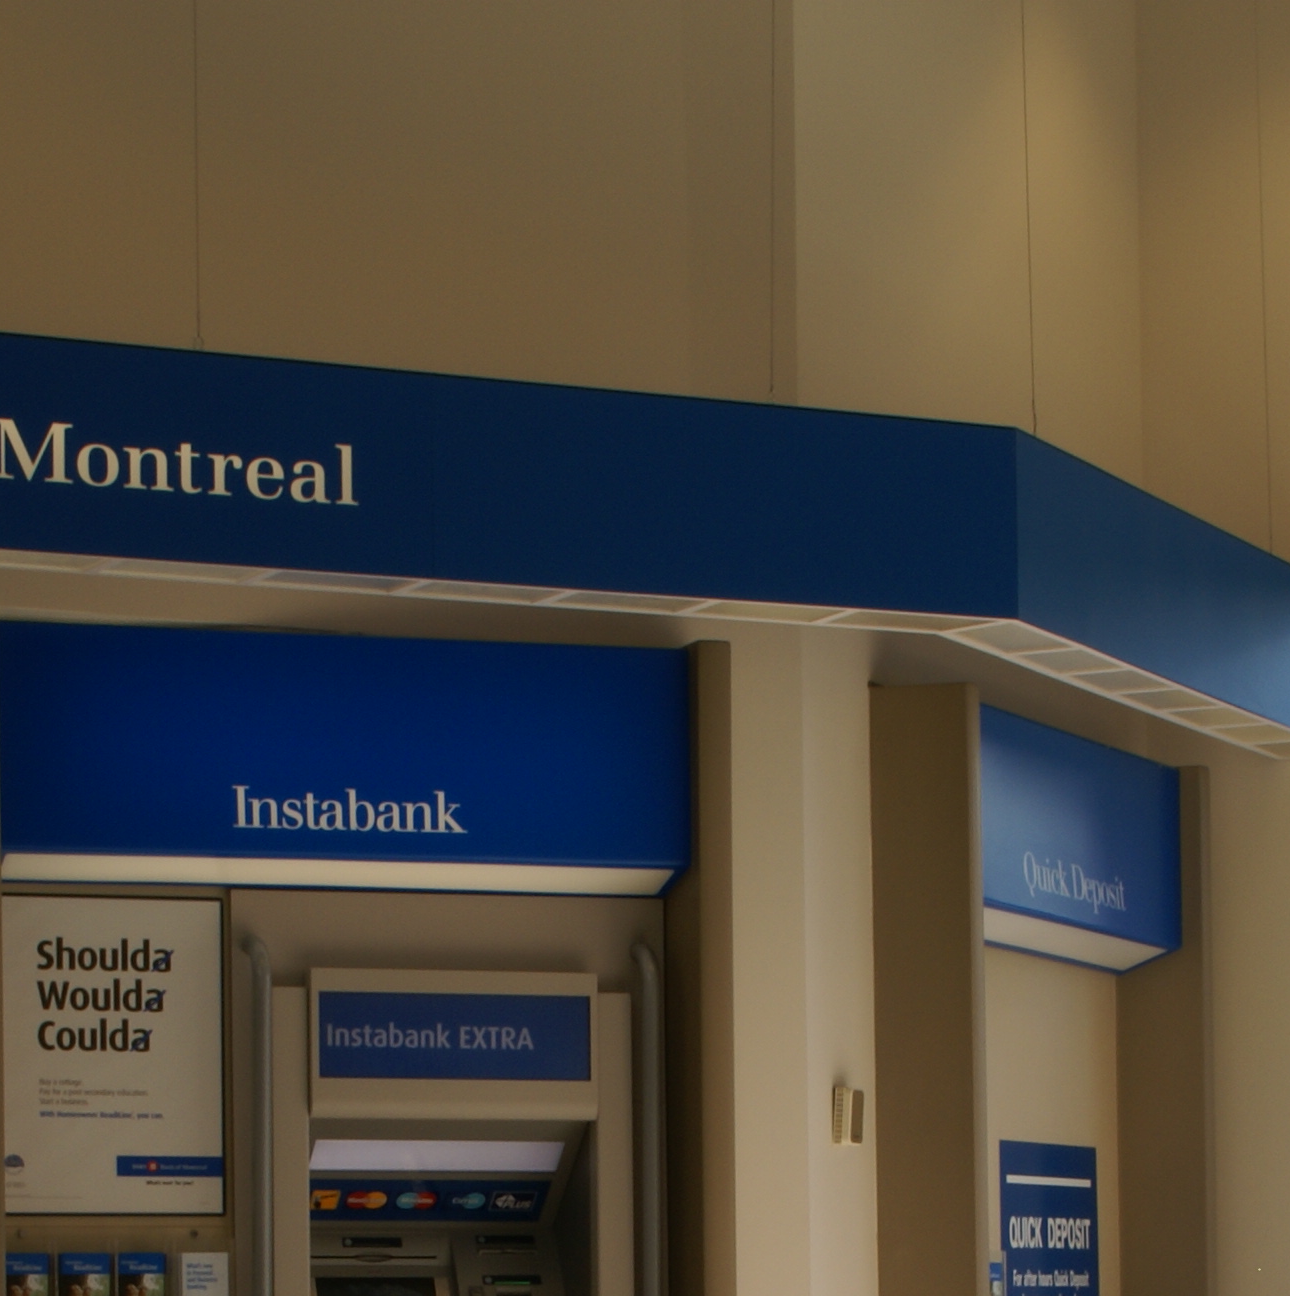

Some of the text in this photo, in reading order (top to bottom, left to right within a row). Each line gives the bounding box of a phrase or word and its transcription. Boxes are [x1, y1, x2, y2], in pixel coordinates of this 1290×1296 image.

[231, 785, 468, 834] Instabank
[1022, 851, 1127, 915] Quick Deposit
[36, 936, 174, 973] Shoulda
[36, 978, 166, 1013] Woulda
[36, 1018, 153, 1053] Coulda
[326, 1021, 535, 1051] Instabank EXTRA
[1009, 1215, 1092, 1250] QUICK DEPOSIT
